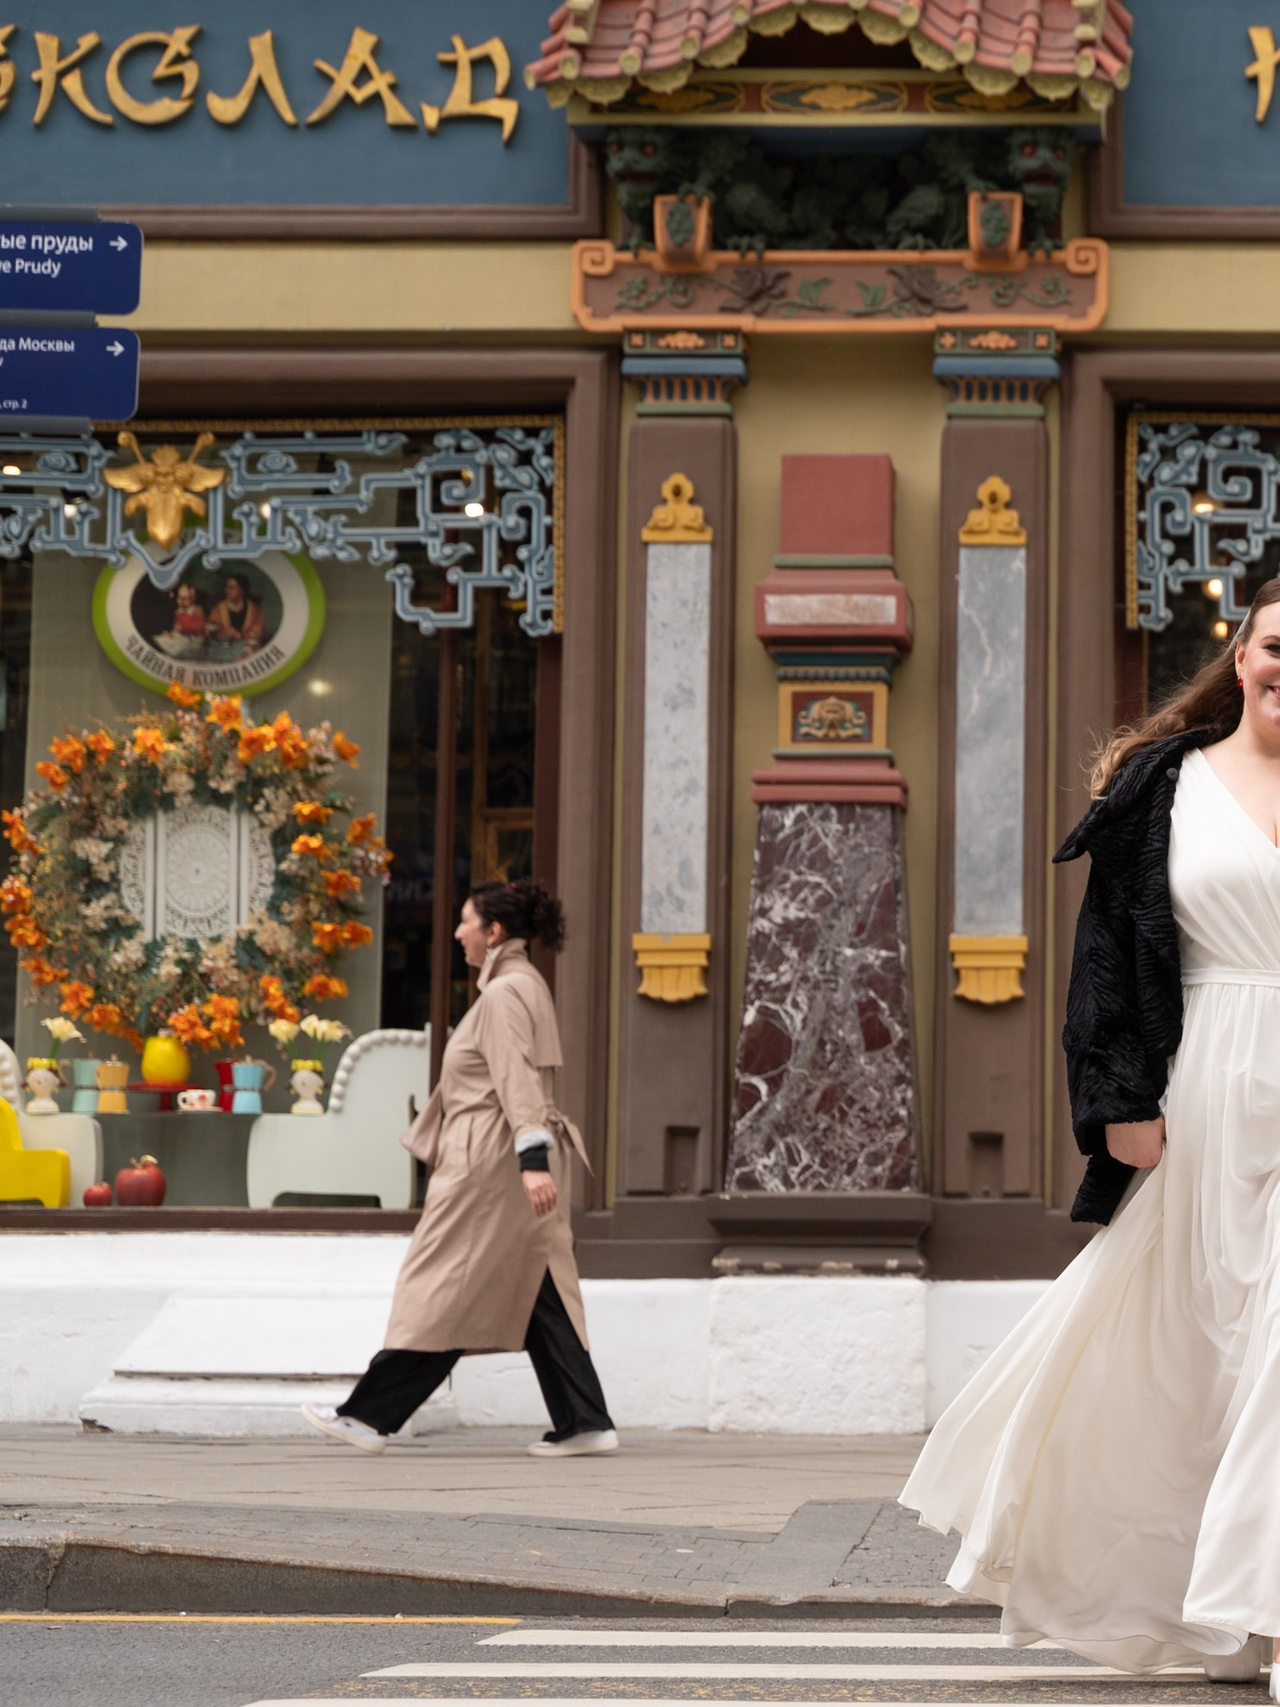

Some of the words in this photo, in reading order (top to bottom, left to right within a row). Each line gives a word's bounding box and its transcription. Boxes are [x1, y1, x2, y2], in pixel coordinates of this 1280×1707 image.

[0, 24, 520, 147] КОЛАД
[0, 233, 27, 250] ые
[31, 234, 94, 255] пруды
[15, 258, 62, 278] Prudy
[19, 336, 75, 352] Москвы
[125, 633, 187, 684] ЧАЙНАЯ
[191, 644, 286, 688] КОМПАНИЯ
